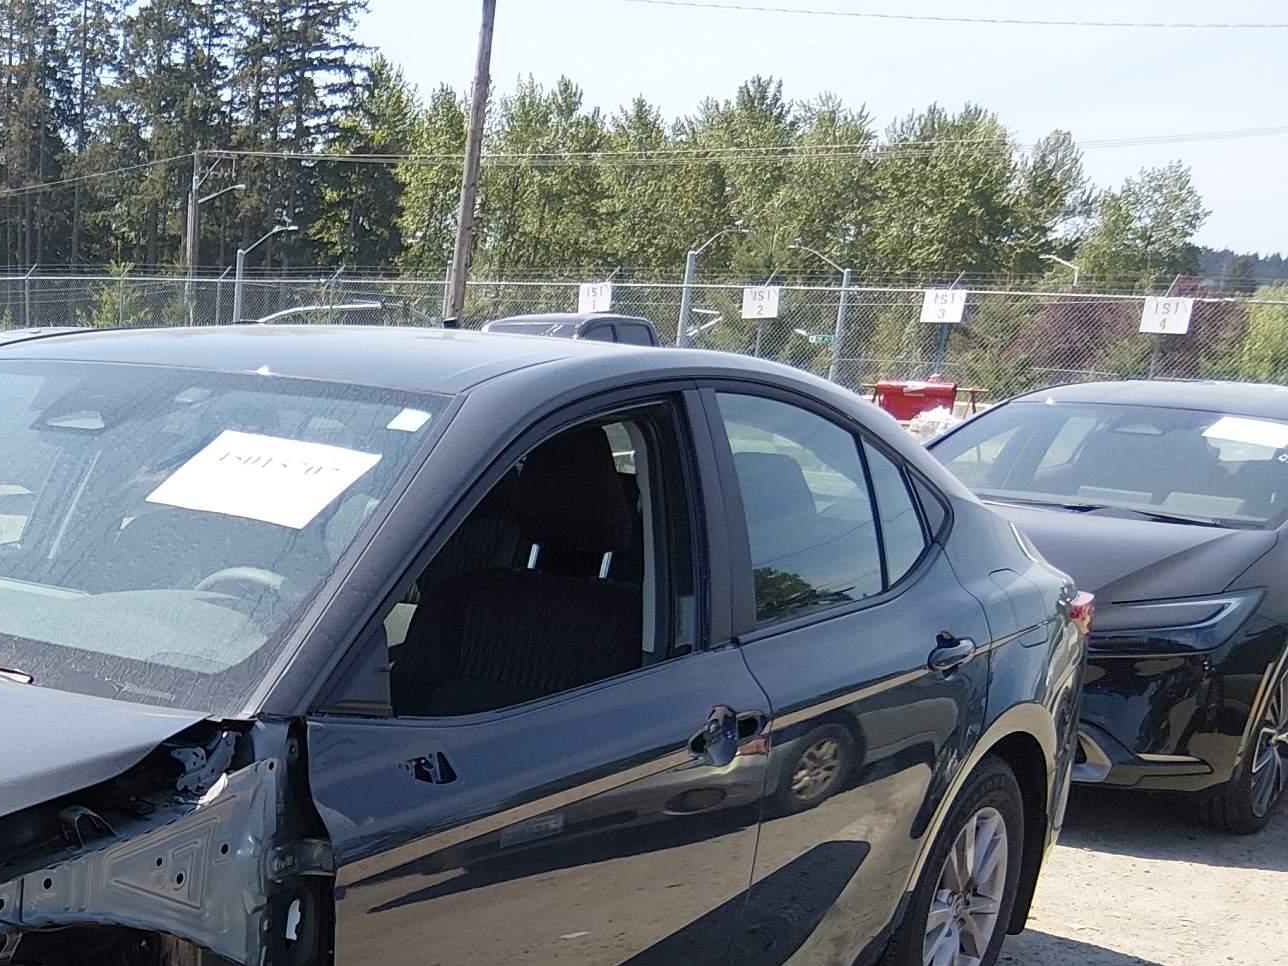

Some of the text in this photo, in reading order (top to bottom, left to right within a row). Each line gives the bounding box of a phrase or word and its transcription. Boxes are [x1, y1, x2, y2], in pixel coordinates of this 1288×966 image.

[756, 304, 764, 316] 2
[937, 308, 946, 320] 3
[1159, 318, 1168, 331] 4
